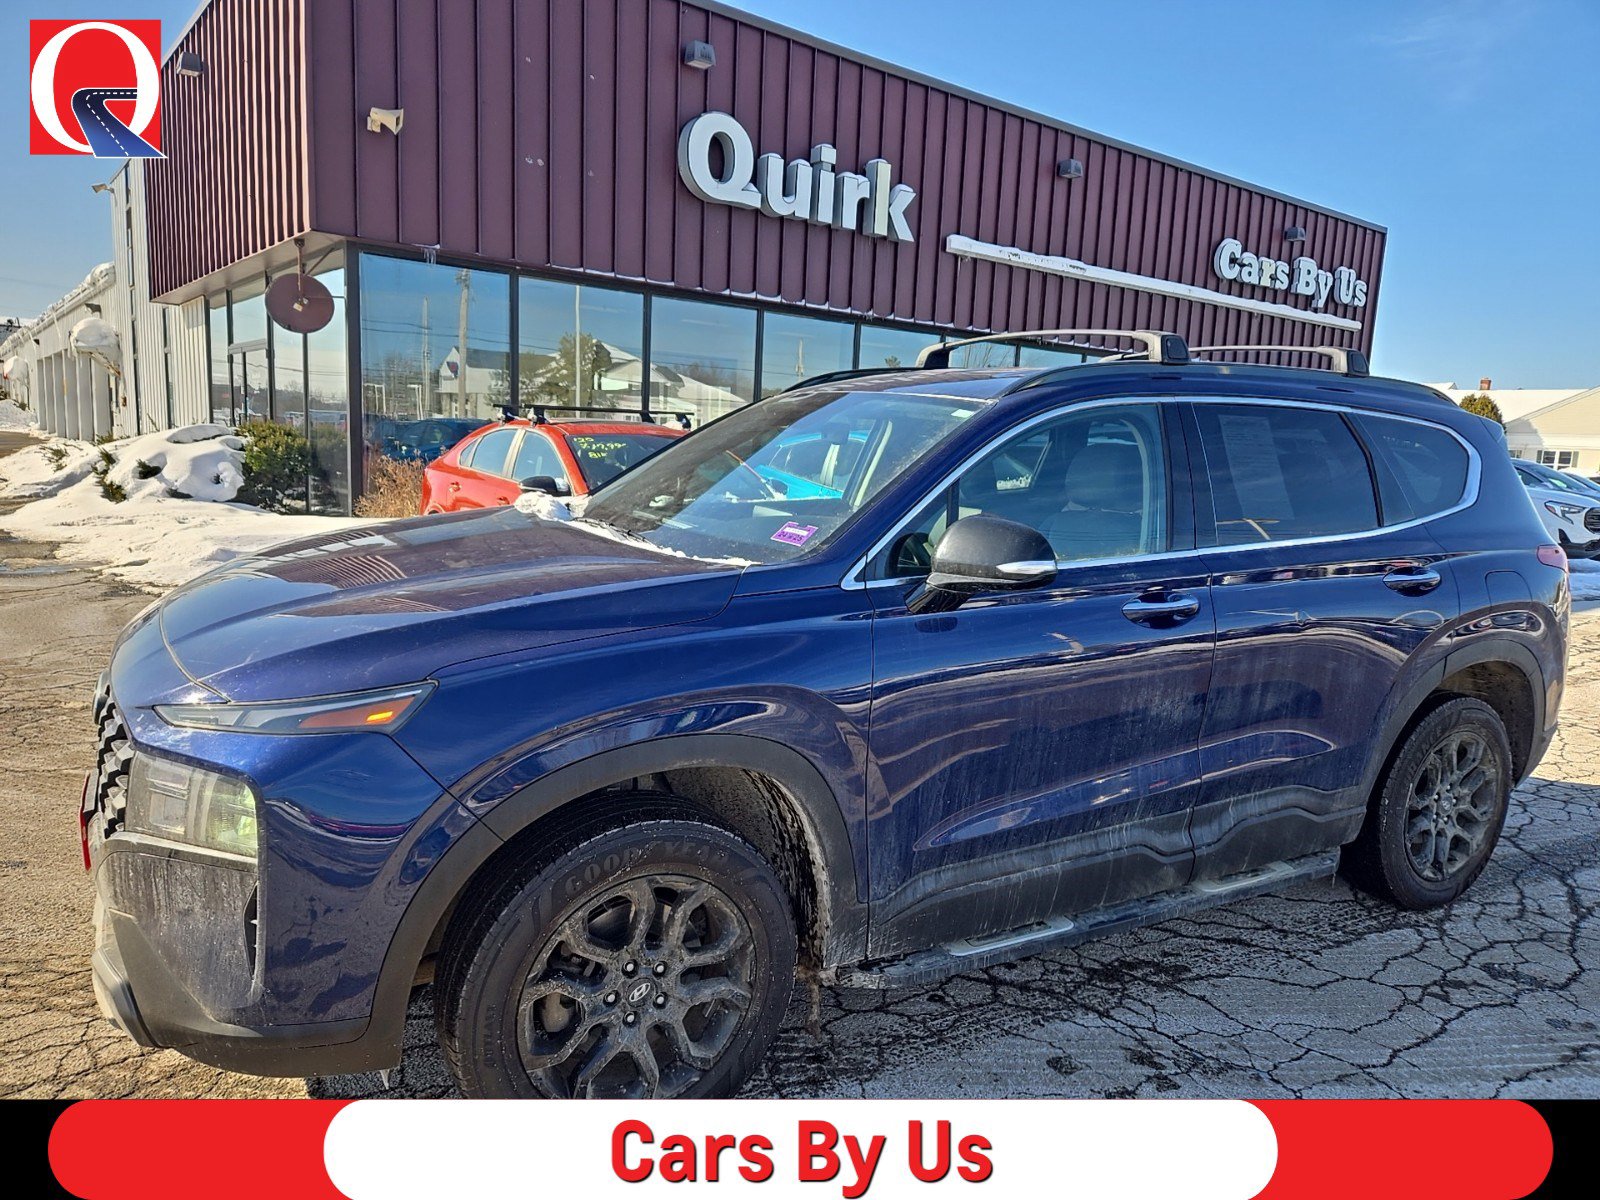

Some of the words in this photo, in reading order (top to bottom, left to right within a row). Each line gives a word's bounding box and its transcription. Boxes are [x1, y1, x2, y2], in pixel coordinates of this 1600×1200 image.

[678, 110, 916, 242] Quirk
[1214, 238, 1289, 290] Cars
[1291, 257, 1333, 308] By
[1334, 266, 1367, 307] Us
